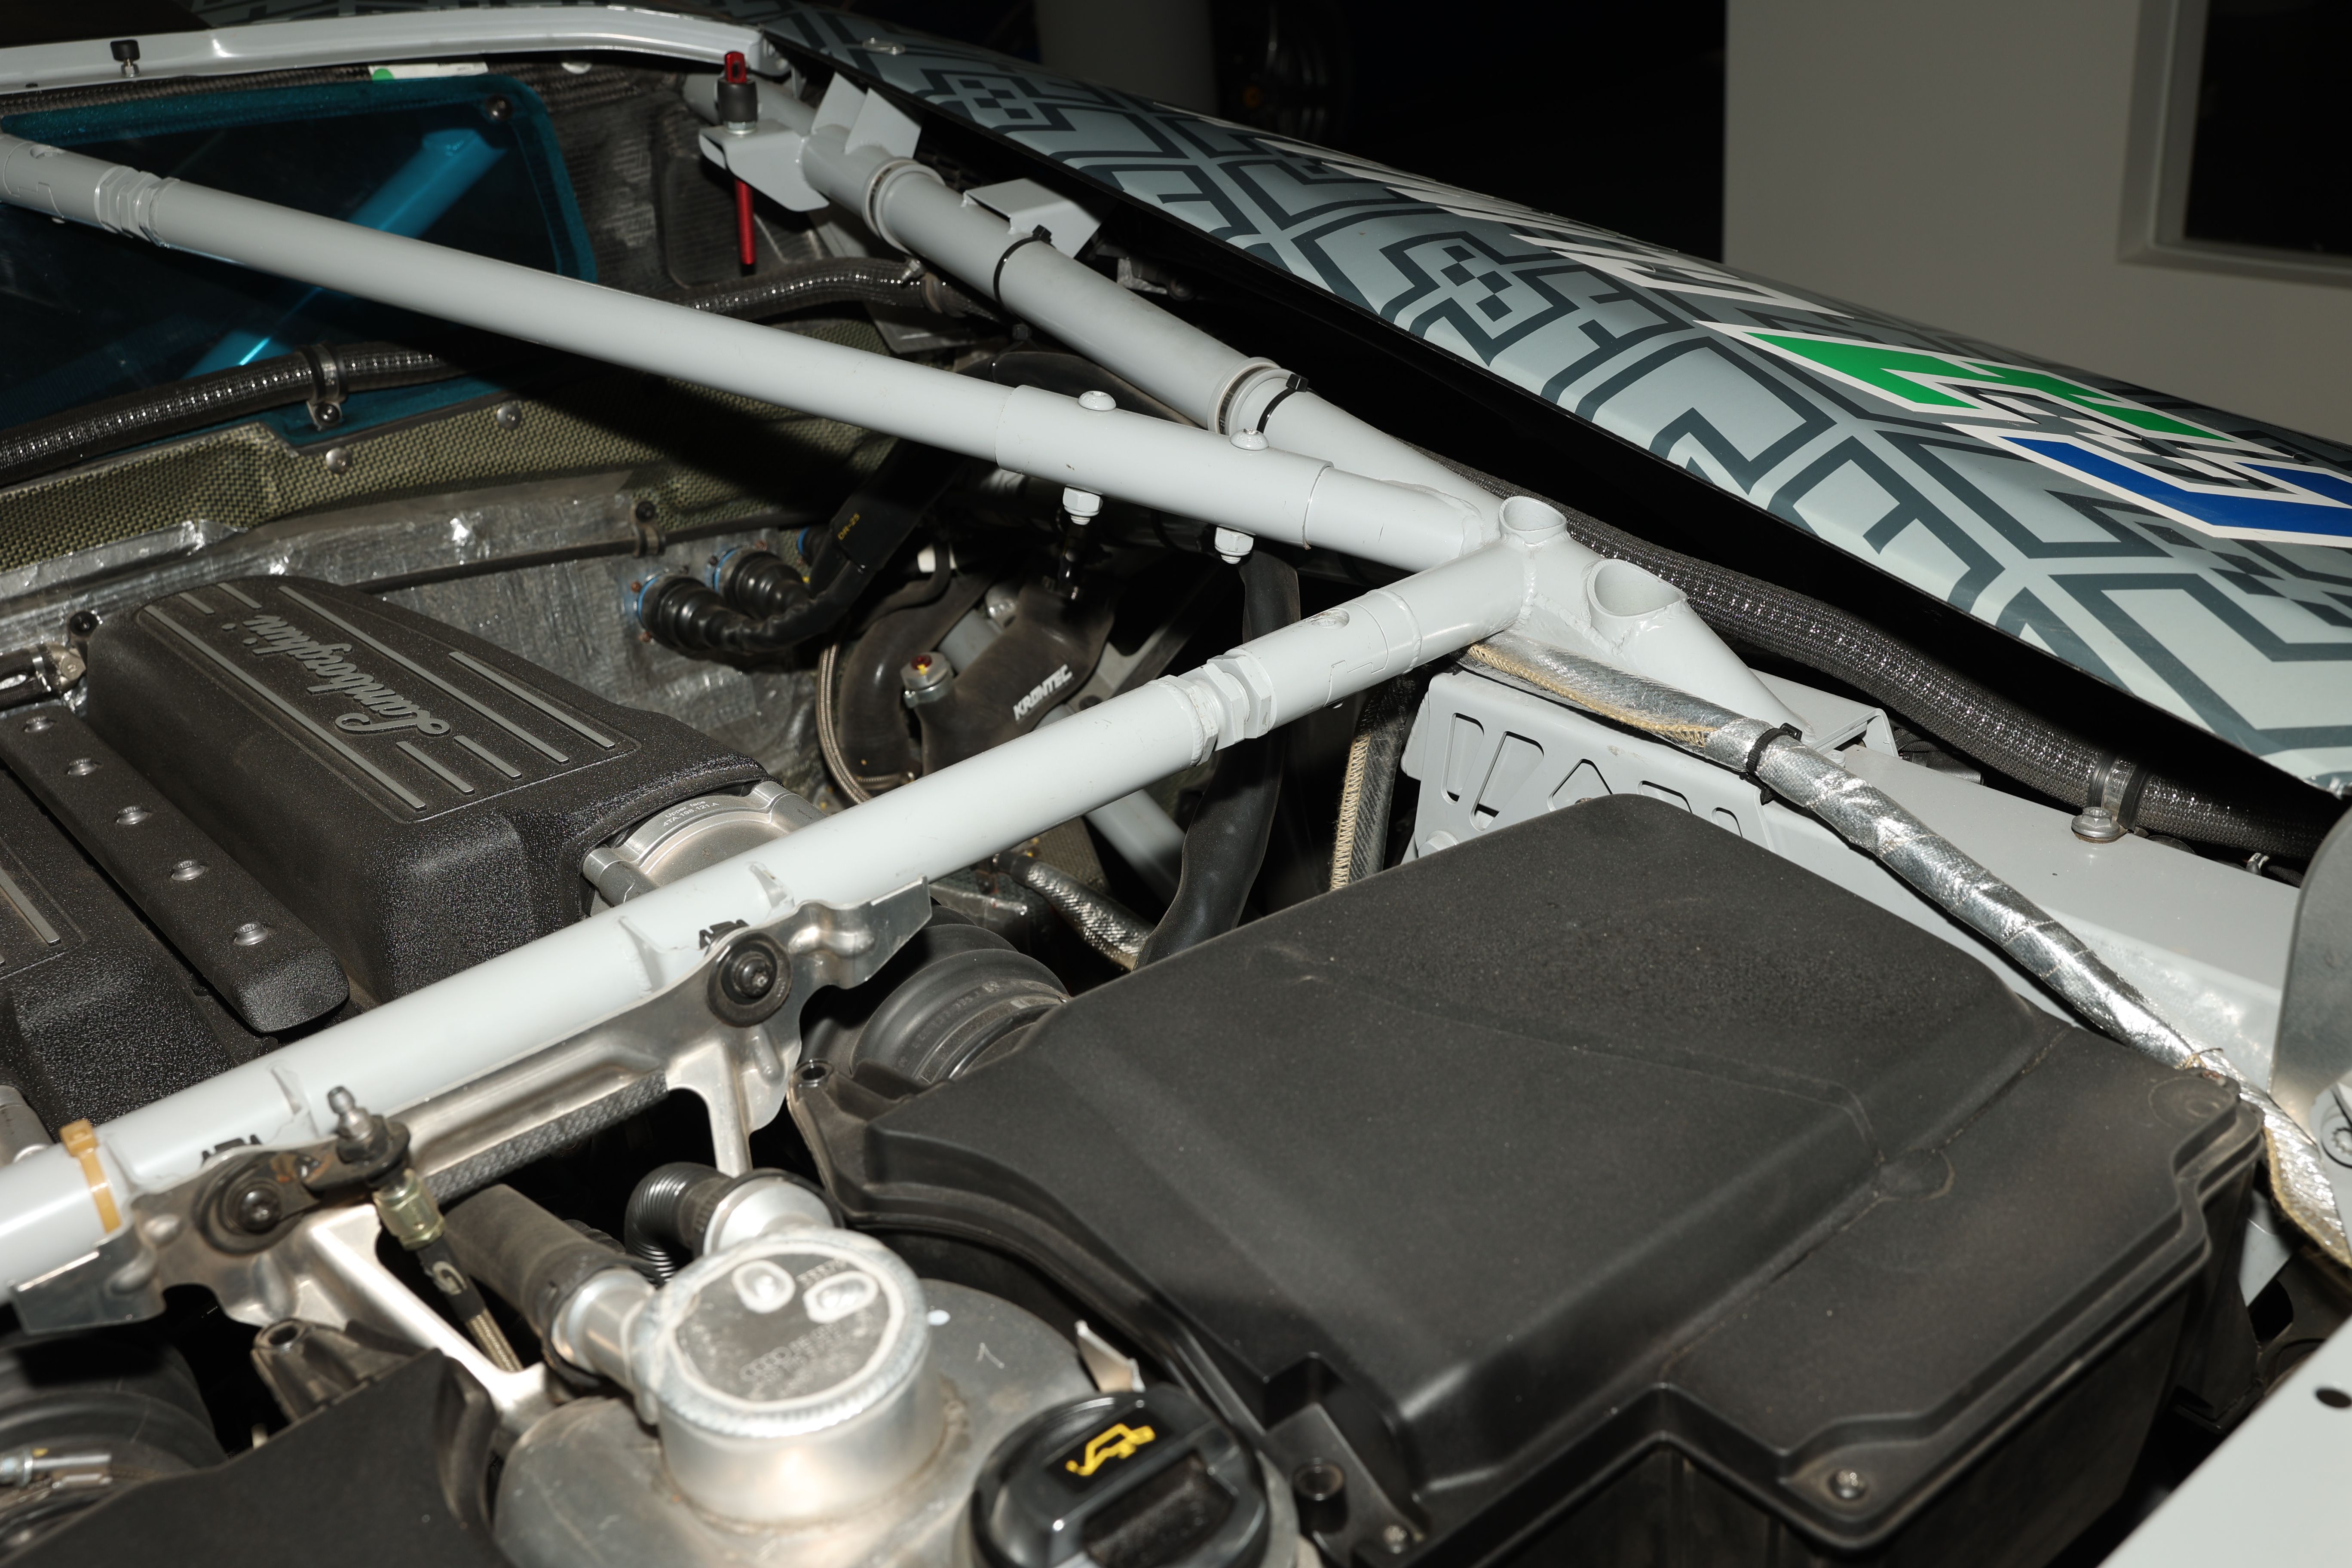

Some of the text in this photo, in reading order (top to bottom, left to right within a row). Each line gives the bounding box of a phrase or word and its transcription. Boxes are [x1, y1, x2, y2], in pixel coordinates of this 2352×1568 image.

[221, 615, 451, 736] Lamborghini
[1013, 664, 1073, 721] KRONTEC
[665, 806, 687, 818] Upper
